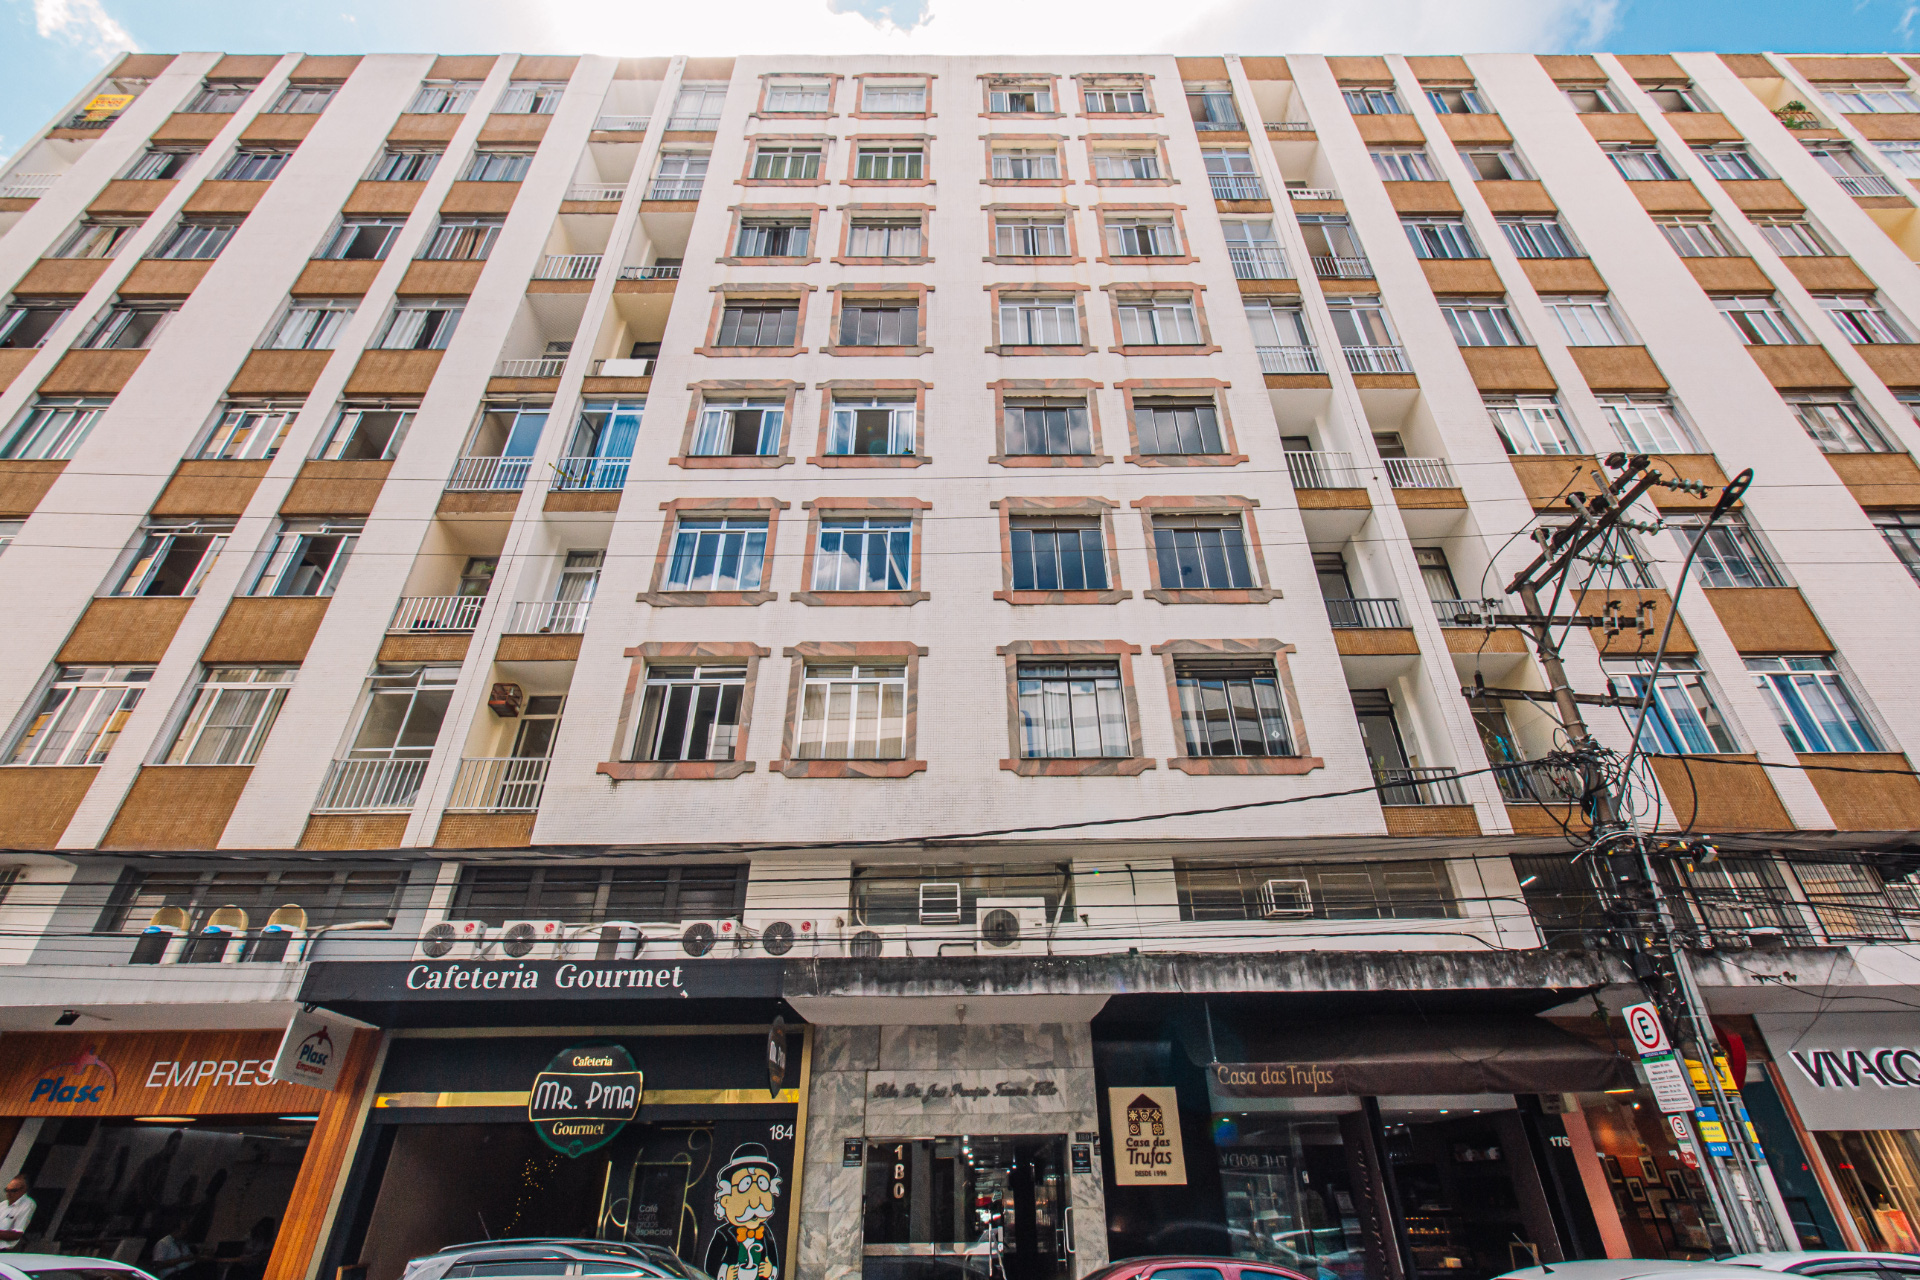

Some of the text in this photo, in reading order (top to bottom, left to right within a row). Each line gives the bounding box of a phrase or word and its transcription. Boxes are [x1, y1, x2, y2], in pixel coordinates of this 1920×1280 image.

[407, 964, 683, 989] Cafeteria Gourmet
[1637, 1016, 1654, 1040] E
[299, 1044, 328, 1065] Plasc
[573, 1056, 613, 1067] Cafeteria
[145, 1059, 293, 1088] EMPRES
[1217, 1064, 1334, 1092] Casa das Trufas
[29, 1076, 104, 1103] Plasc
[534, 1081, 577, 1109] MR.
[553, 1122, 605, 1135] Gourmet
[769, 1124, 794, 1140] 184
[1126, 1137, 1170, 1147] Casa das
[1549, 1136, 1570, 1147] 176
[1126, 1146, 1172, 1168] Trufas
[894, 1144, 905, 1199] 180
[639, 1204, 658, 1212] Café
